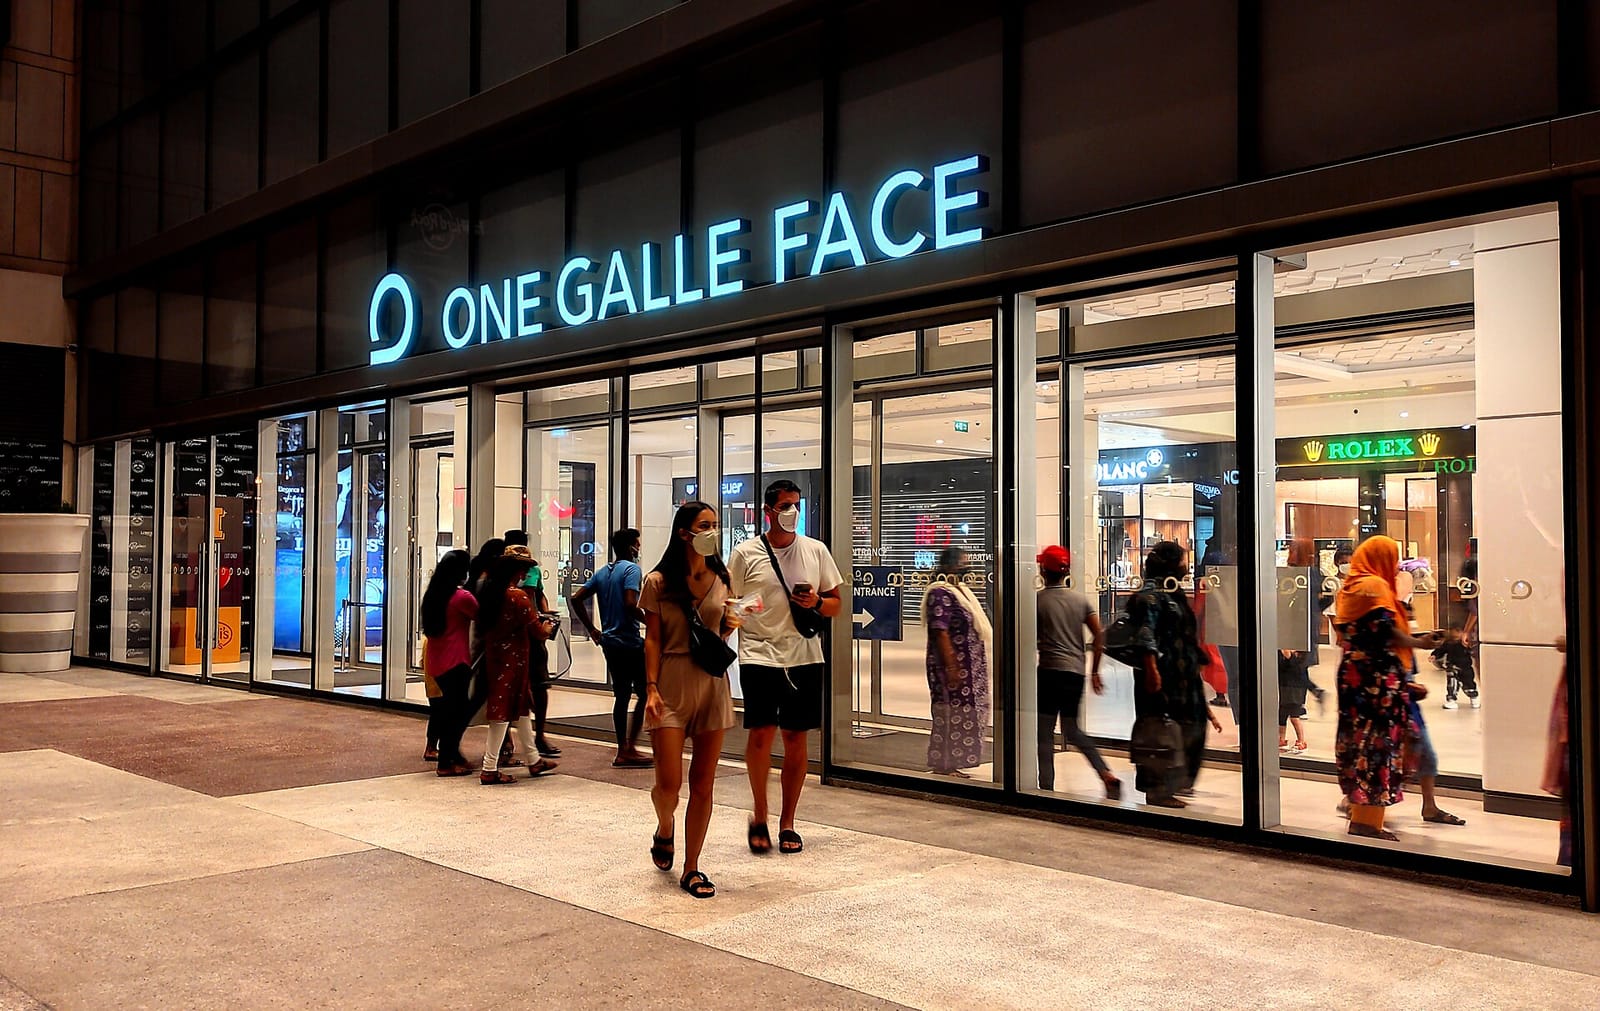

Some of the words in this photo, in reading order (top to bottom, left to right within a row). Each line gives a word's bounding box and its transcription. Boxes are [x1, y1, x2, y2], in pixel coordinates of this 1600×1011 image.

[442, 271, 544, 349] ONE
[556, 218, 744, 327] GALLE
[774, 154, 985, 284] FACE
[1328, 438, 1414, 460] ROLEX
[722, 482, 744, 495] euer
[853, 587, 896, 597] NTRANCE
